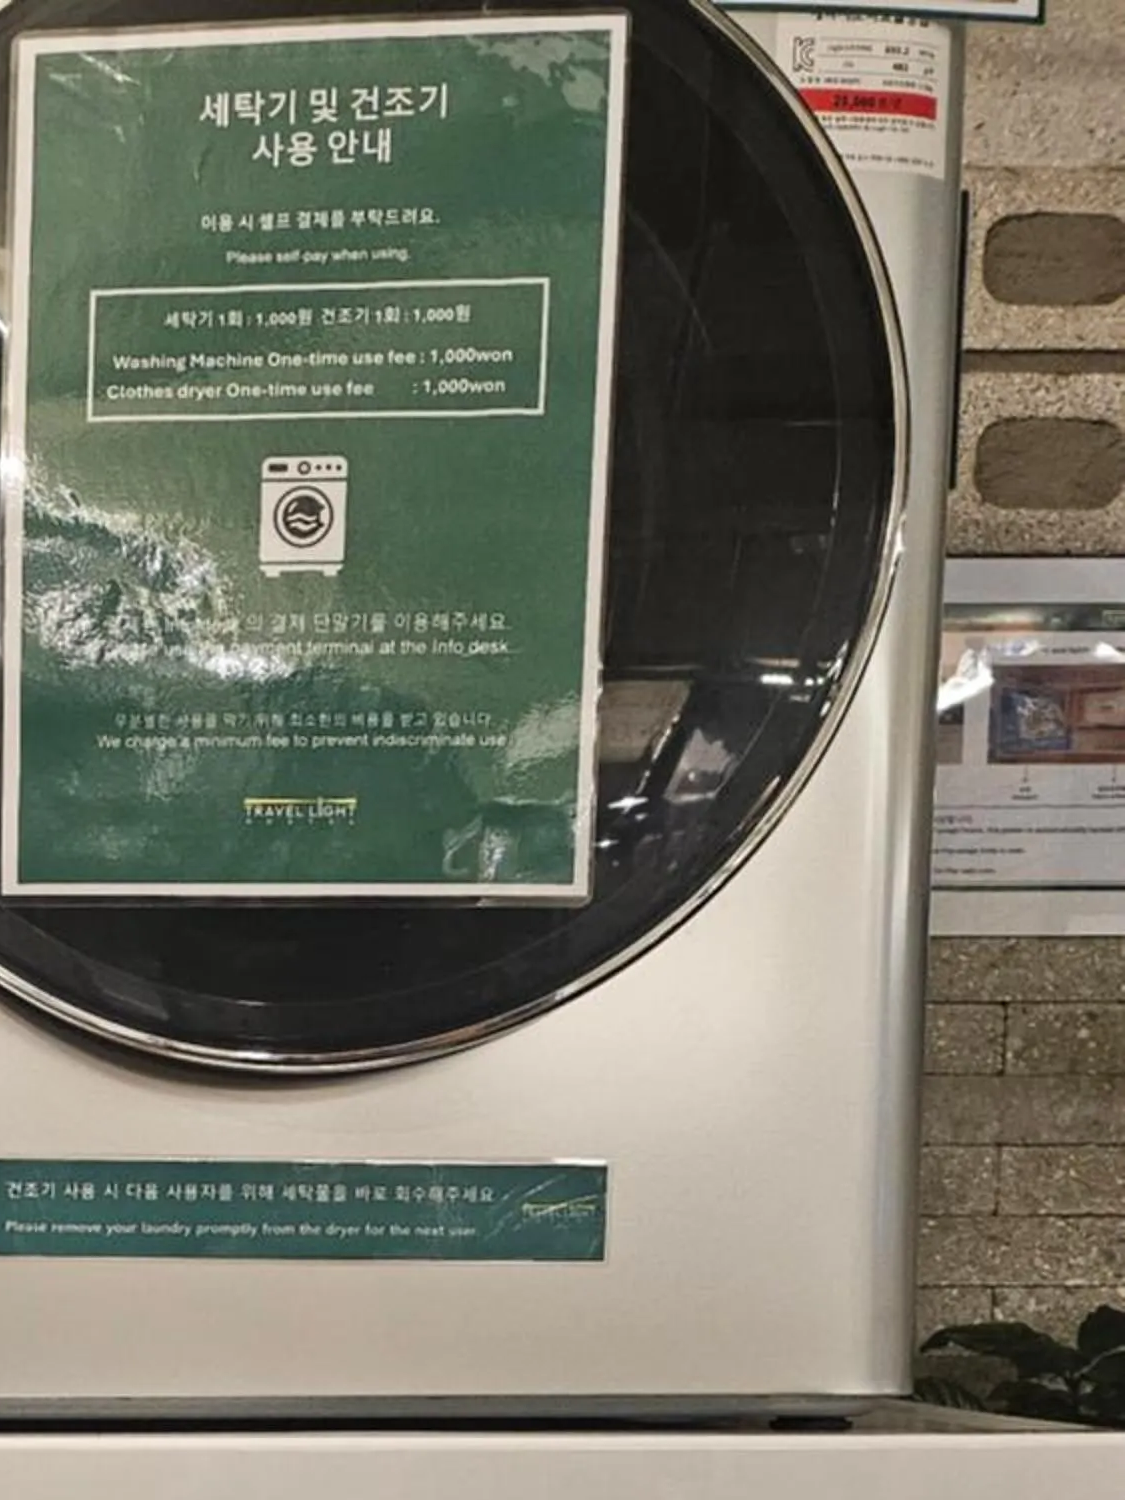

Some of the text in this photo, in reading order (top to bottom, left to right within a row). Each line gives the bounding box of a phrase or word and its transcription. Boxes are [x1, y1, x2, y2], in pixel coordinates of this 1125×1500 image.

[199, 82, 448, 128] 세탁기 및 건조기
[252, 127, 391, 168] 사용 안내
[200, 208, 441, 234] 이용 시 셀프 결제를 부탁드려요.
[226, 250, 273, 264] Please
[332, 249, 369, 262] when
[163, 310, 214, 329] 세탁기
[257, 308, 313, 327] 1,000원
[321, 306, 370, 325] 건조기
[414, 304, 472, 324] 1,000원
[112, 355, 187, 372] Washing
[190, 352, 264, 370] Machine
[267, 351, 349, 367] One-time
[352, 353, 384, 366] use
[388, 350, 417, 365] fee
[431, 348, 513, 365] 1,000won
[106, 384, 174, 400] Clothes
[177, 383, 222, 400] dryer
[226, 382, 307, 398] One-time
[312, 384, 342, 396] use
[346, 380, 375, 395] fee
[424, 379, 506, 396] 1,000won
[272, 613, 305, 634] 결제
[314, 612, 387, 634] 단말기를
[305, 640, 374, 655] terminal
[379, 639, 396, 655] at
[400, 639, 427, 655] the
[431, 638, 464, 655] Info
[96, 734, 121, 749] We
[125, 734, 176, 752] charge
[194, 734, 262, 749] minimum
[266, 732, 290, 748] fee
[292, 733, 309, 748] to
[311, 734, 368, 750] prevent
[372, 732, 475, 748] indiscriminate
[5, 1181, 56, 1200] 건조기
[64, 1182, 95, 1200] 사용
[104, 1182, 119, 1200] 시
[126, 1182, 159, 1201] 다음
[166, 1182, 233, 1202] 사용자를
[242, 1183, 274, 1201] 위해
[283, 1183, 347, 1203] 세탁물을
[355, 1184, 387, 1202] 바로
[5, 1220, 47, 1233] Please
[51, 1222, 102, 1234] remove
[106, 1223, 137, 1237] your
[141, 1221, 191, 1237] laundry
[195, 1223, 257, 1239] promptly
[261, 1222, 295, 1236] from
[299, 1222, 322, 1236] the
[325, 1223, 361, 1239] dryer
[364, 1222, 385, 1236] for
[389, 1222, 411, 1236] the
[414, 1225, 445, 1237] next
